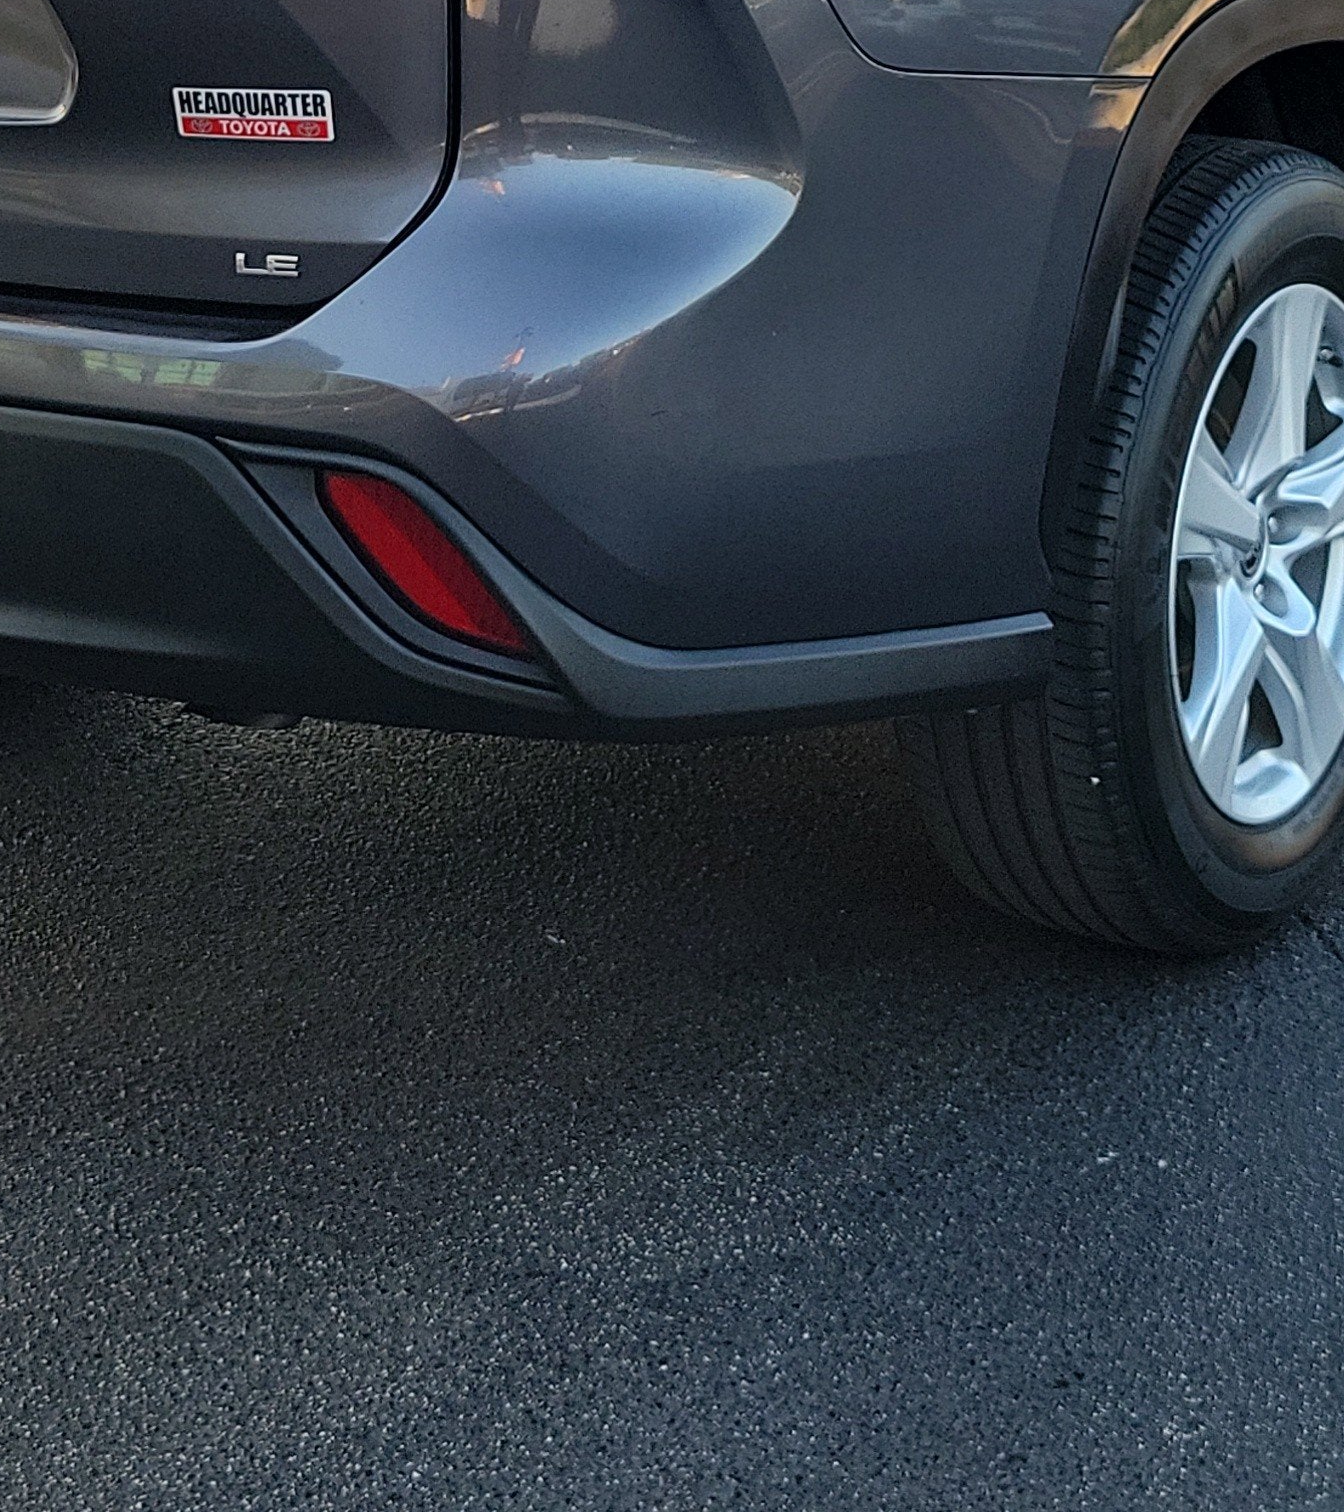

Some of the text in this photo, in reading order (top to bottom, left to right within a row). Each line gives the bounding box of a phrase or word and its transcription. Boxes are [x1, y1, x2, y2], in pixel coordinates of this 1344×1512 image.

[178, 90, 327, 117] HEADQUARTER
[219, 120, 291, 136] TOYOTA
[235, 252, 299, 277] LE
